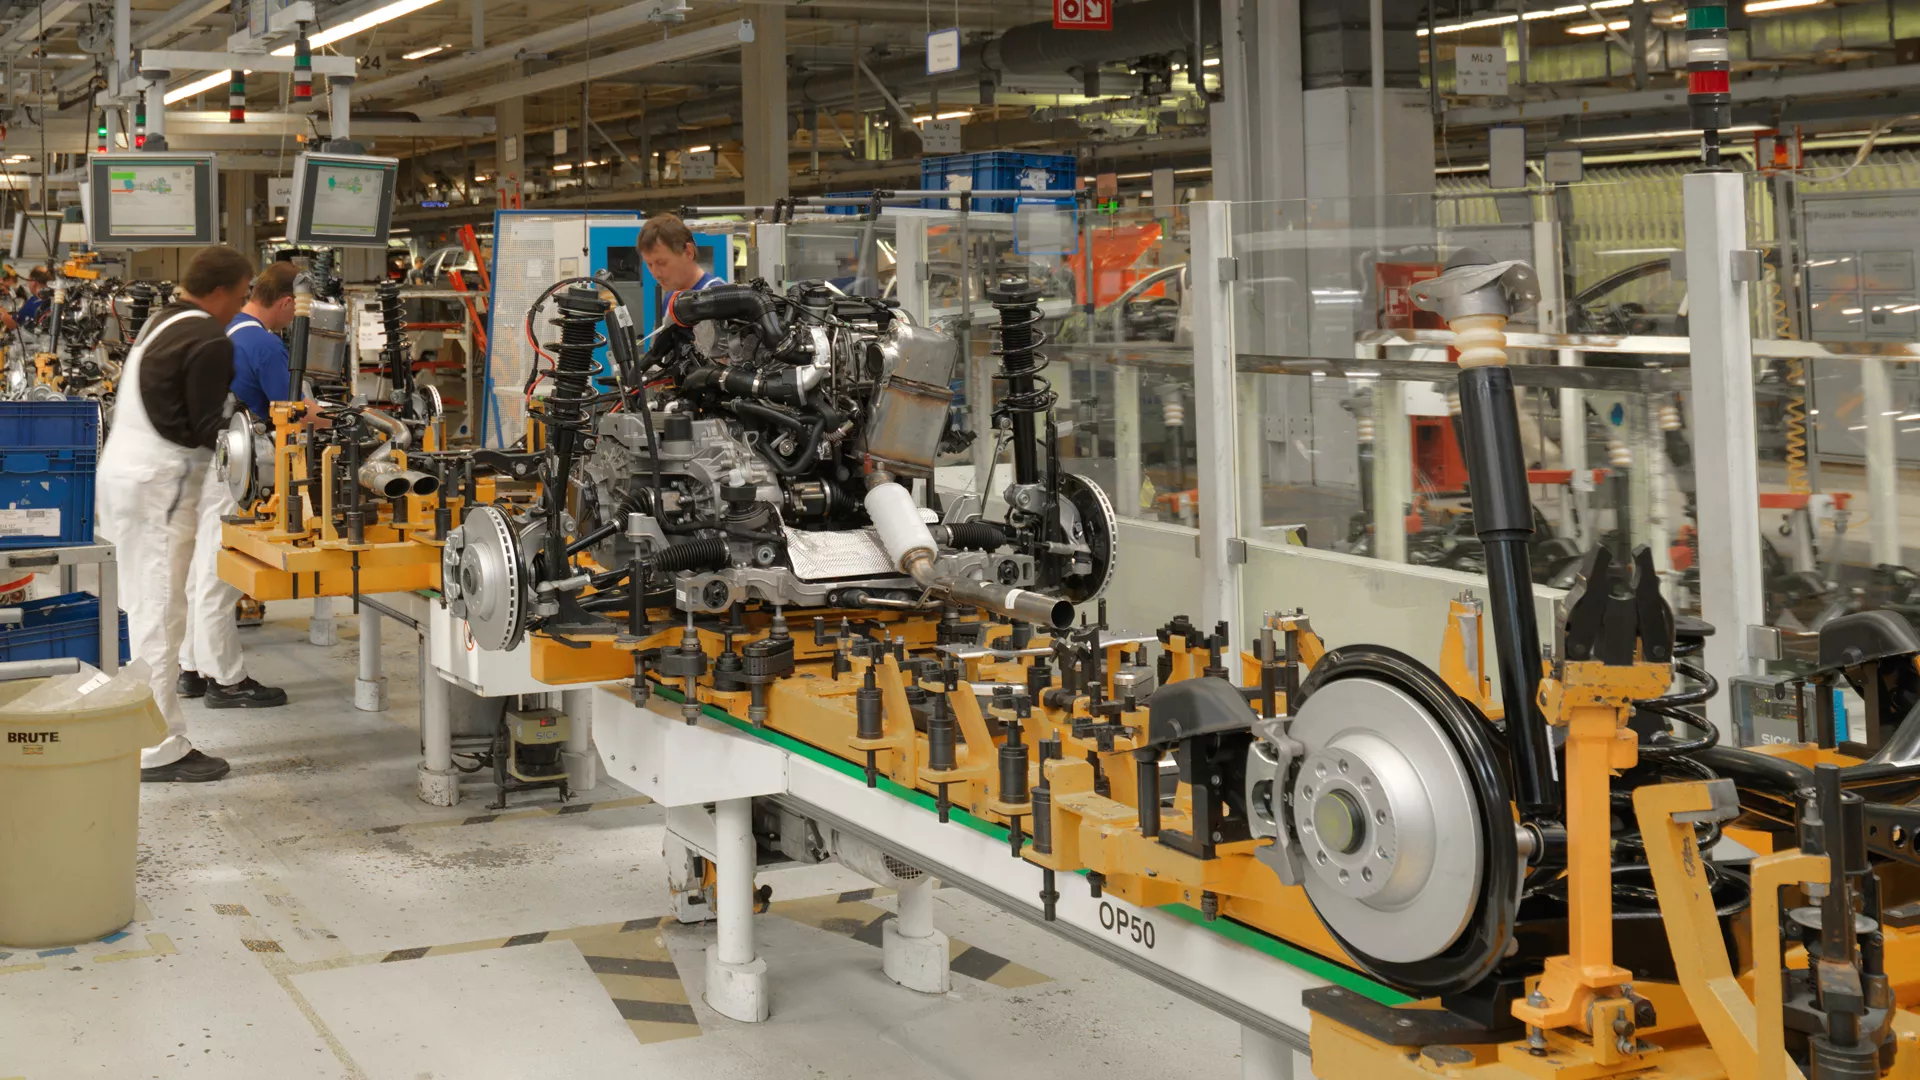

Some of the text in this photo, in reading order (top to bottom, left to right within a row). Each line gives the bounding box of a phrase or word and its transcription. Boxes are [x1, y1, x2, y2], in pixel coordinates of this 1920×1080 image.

[361, 54, 381, 70] 24
[1471, 53, 1493, 63] ML-2
[933, 123, 950, 131] ML-2
[7, 731, 59, 743] BRUTE
[1099, 901, 1155, 950] OP50
